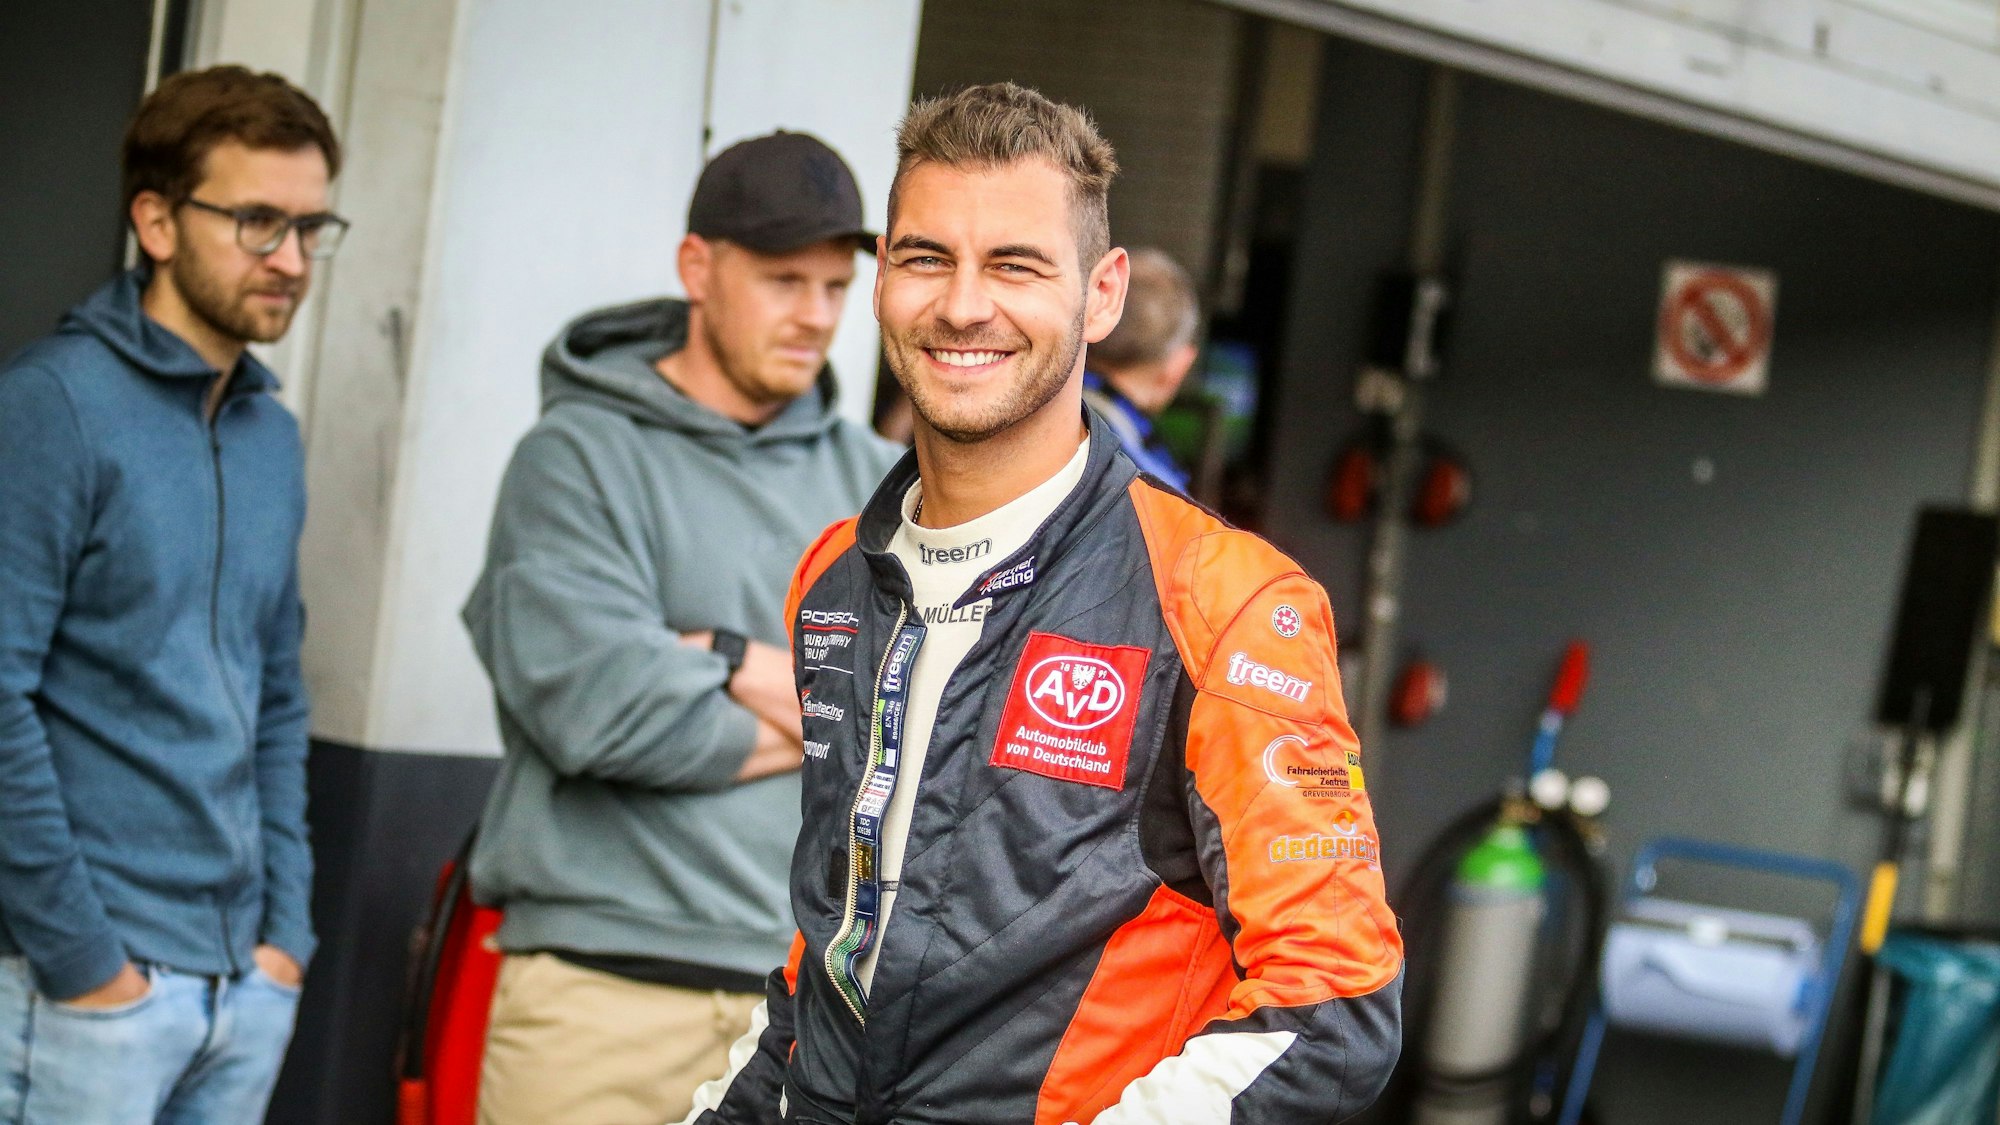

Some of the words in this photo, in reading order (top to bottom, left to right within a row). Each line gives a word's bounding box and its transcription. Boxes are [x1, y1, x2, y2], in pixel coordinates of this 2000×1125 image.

[918, 538, 992, 566] freem
[981, 568, 1034, 595] Racing
[883, 634, 914, 692] freem
[1060, 661, 1070, 672] 18
[1226, 651, 1310, 702] freem
[1015, 725, 1107, 756] Automobilclub
[1006, 742, 1029, 756] von
[1032, 745, 1111, 774] Deutschland
[1319, 777, 1349, 787] Zentrum
